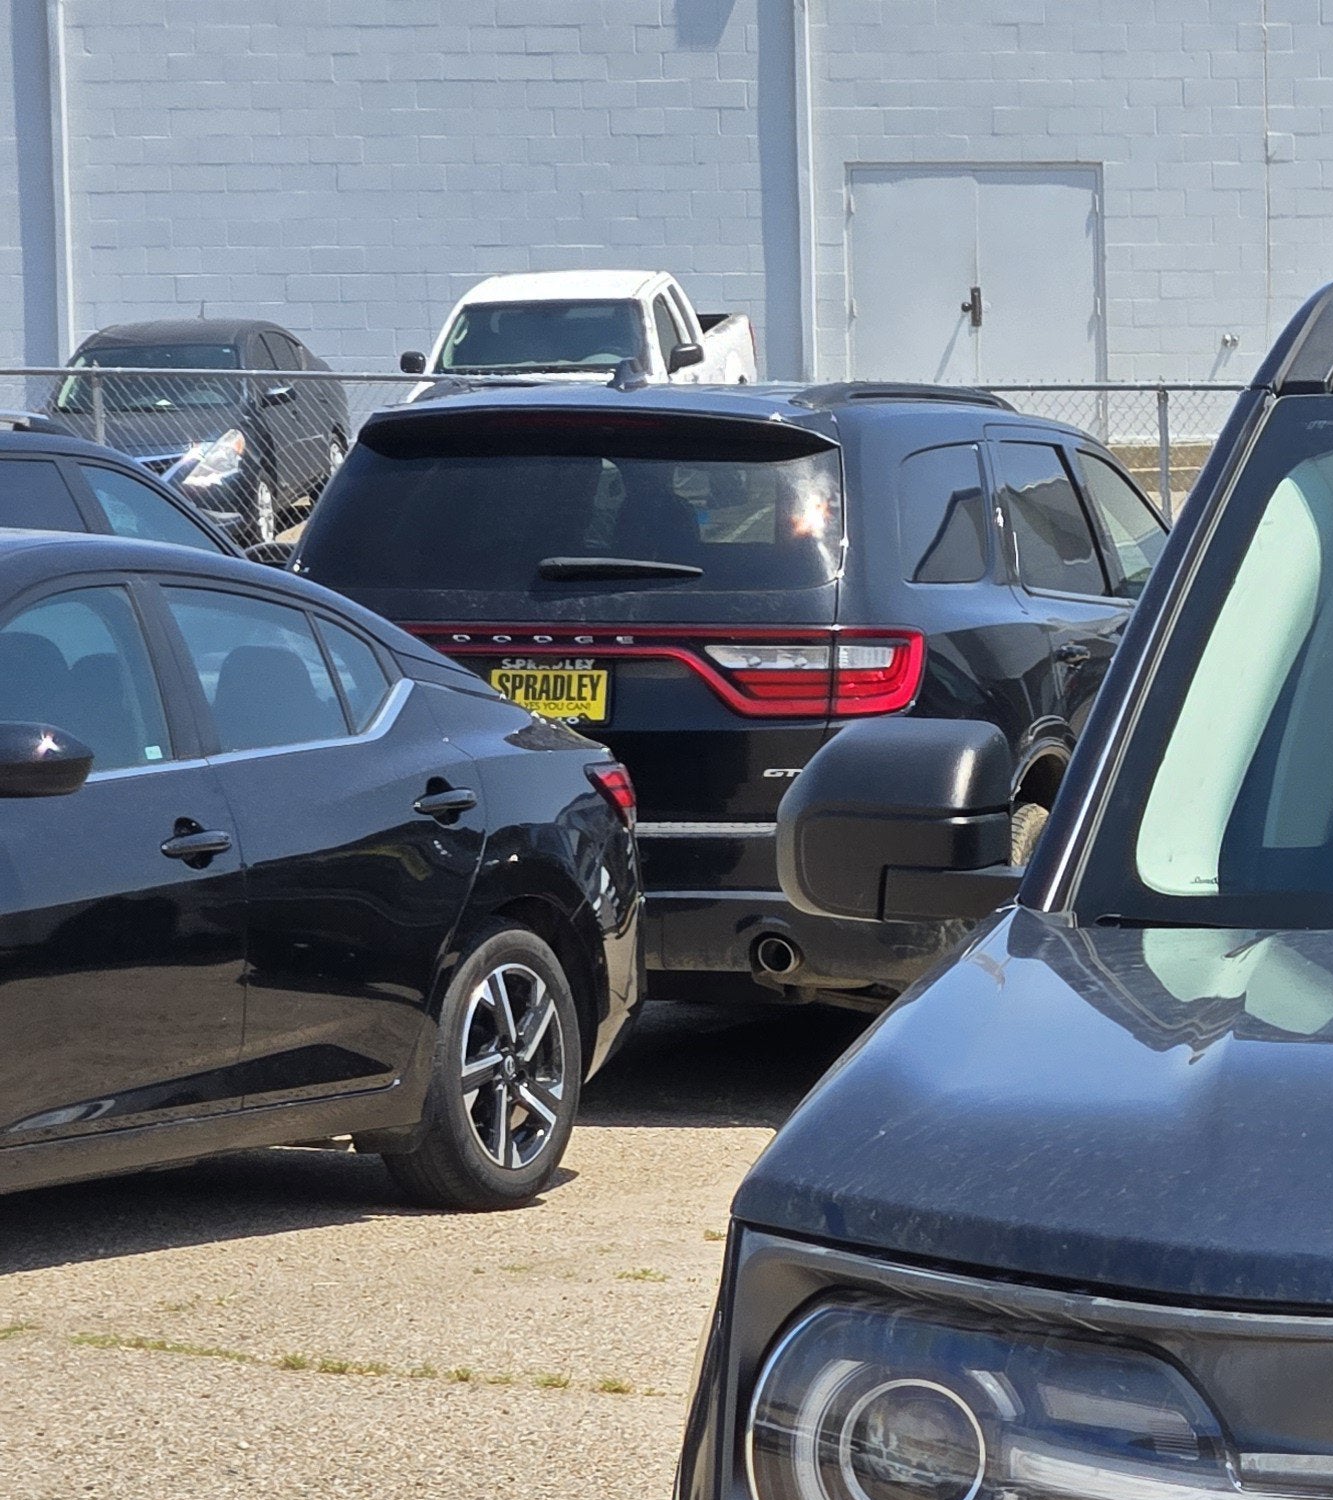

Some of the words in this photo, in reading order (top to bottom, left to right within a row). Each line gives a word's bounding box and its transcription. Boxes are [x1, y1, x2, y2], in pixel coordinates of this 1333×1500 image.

[452, 634, 635, 645] DODGE
[498, 674, 602, 702] SPRADLEY
[525, 701, 541, 711] YES
[543, 702, 564, 711] YOU
[763, 768, 804, 778] GT
